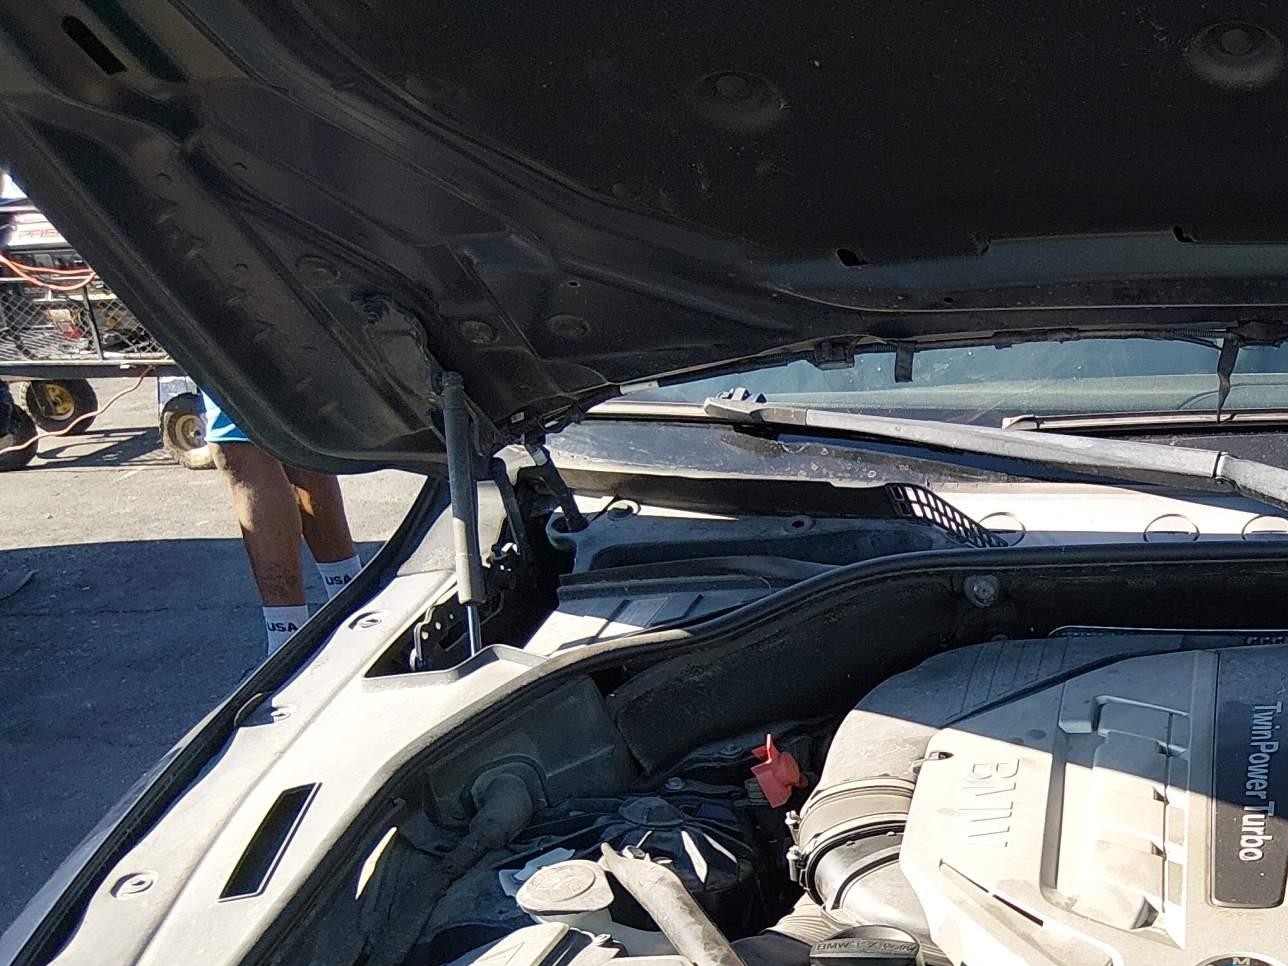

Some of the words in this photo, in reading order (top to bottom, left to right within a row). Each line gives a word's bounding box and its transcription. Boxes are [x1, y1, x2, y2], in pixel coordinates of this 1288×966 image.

[325, 574, 352, 586] USA
[267, 622, 298, 632] USA
[1245, 701, 1282, 799] TwinPower
[1238, 801, 1275, 862] Turbo
